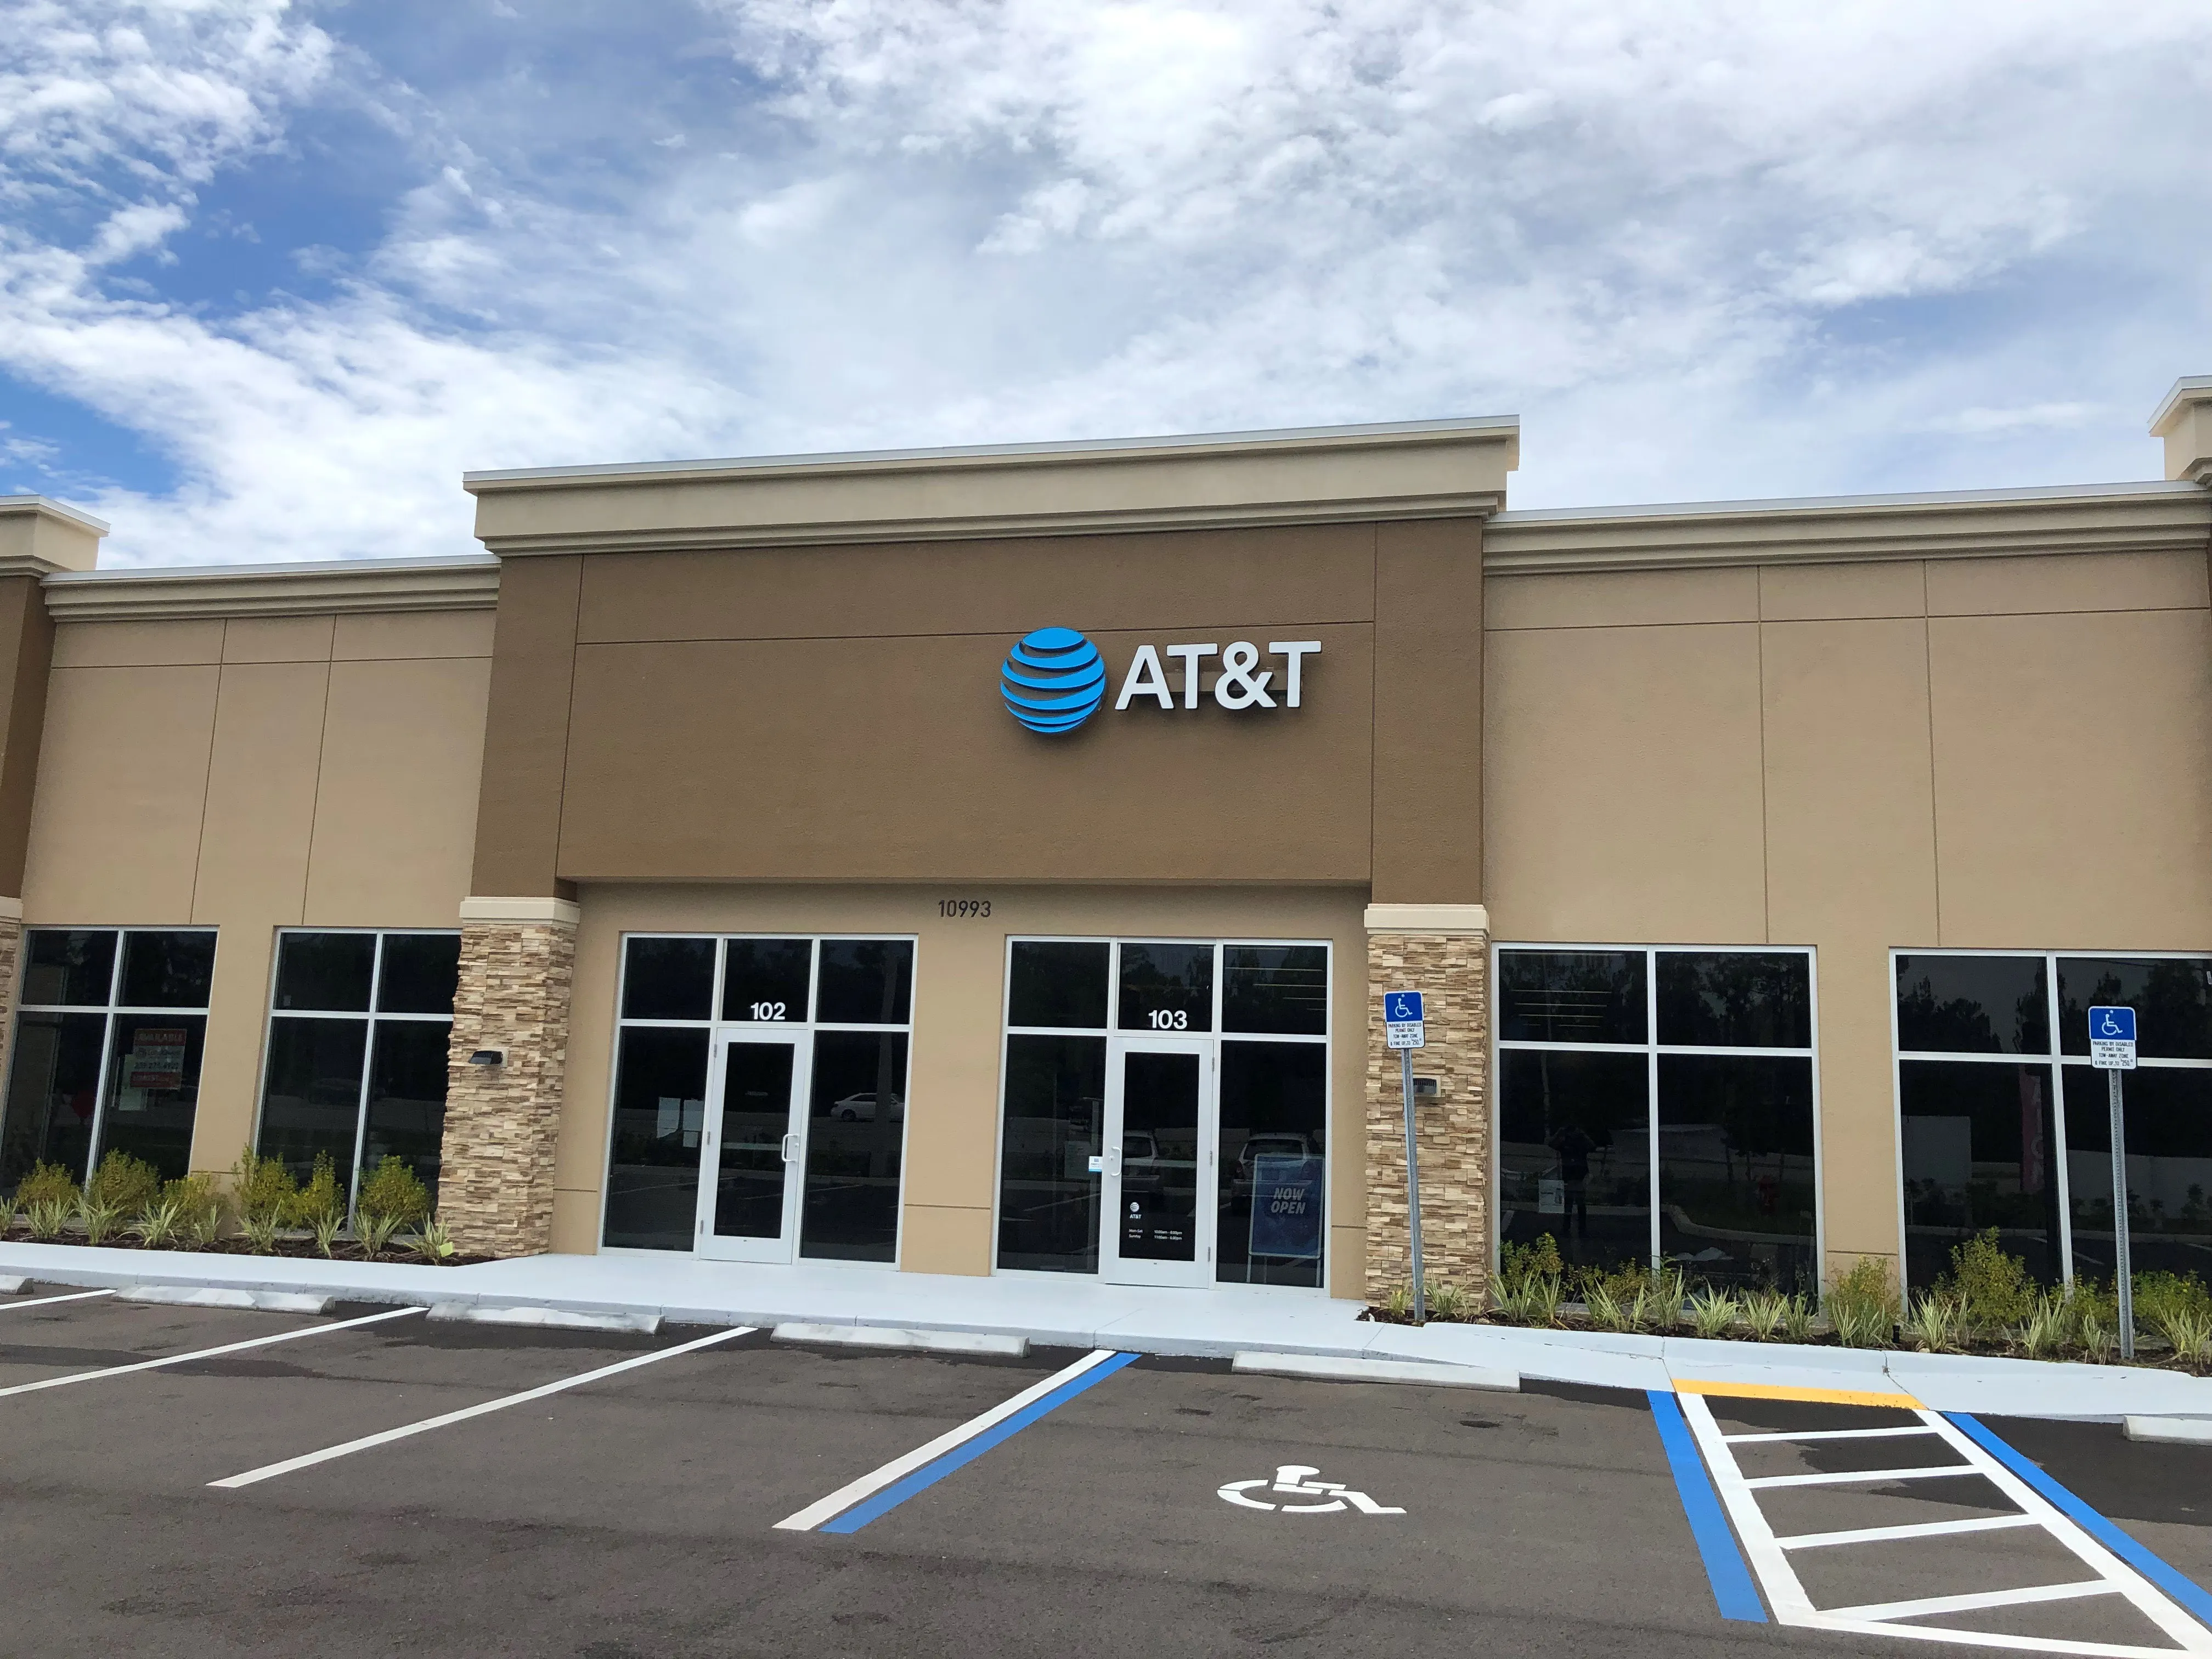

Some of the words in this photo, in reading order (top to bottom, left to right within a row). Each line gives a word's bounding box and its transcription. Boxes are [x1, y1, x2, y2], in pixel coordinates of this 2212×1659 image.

[1115, 640, 1322, 710] AT&T
[938, 900, 991, 918] 10993
[750, 1002, 786, 1020] 102
[1148, 1009, 1188, 1029] 103
[1273, 1187, 1305, 1201] NOW
[1271, 1201, 1306, 1214] OPEN
